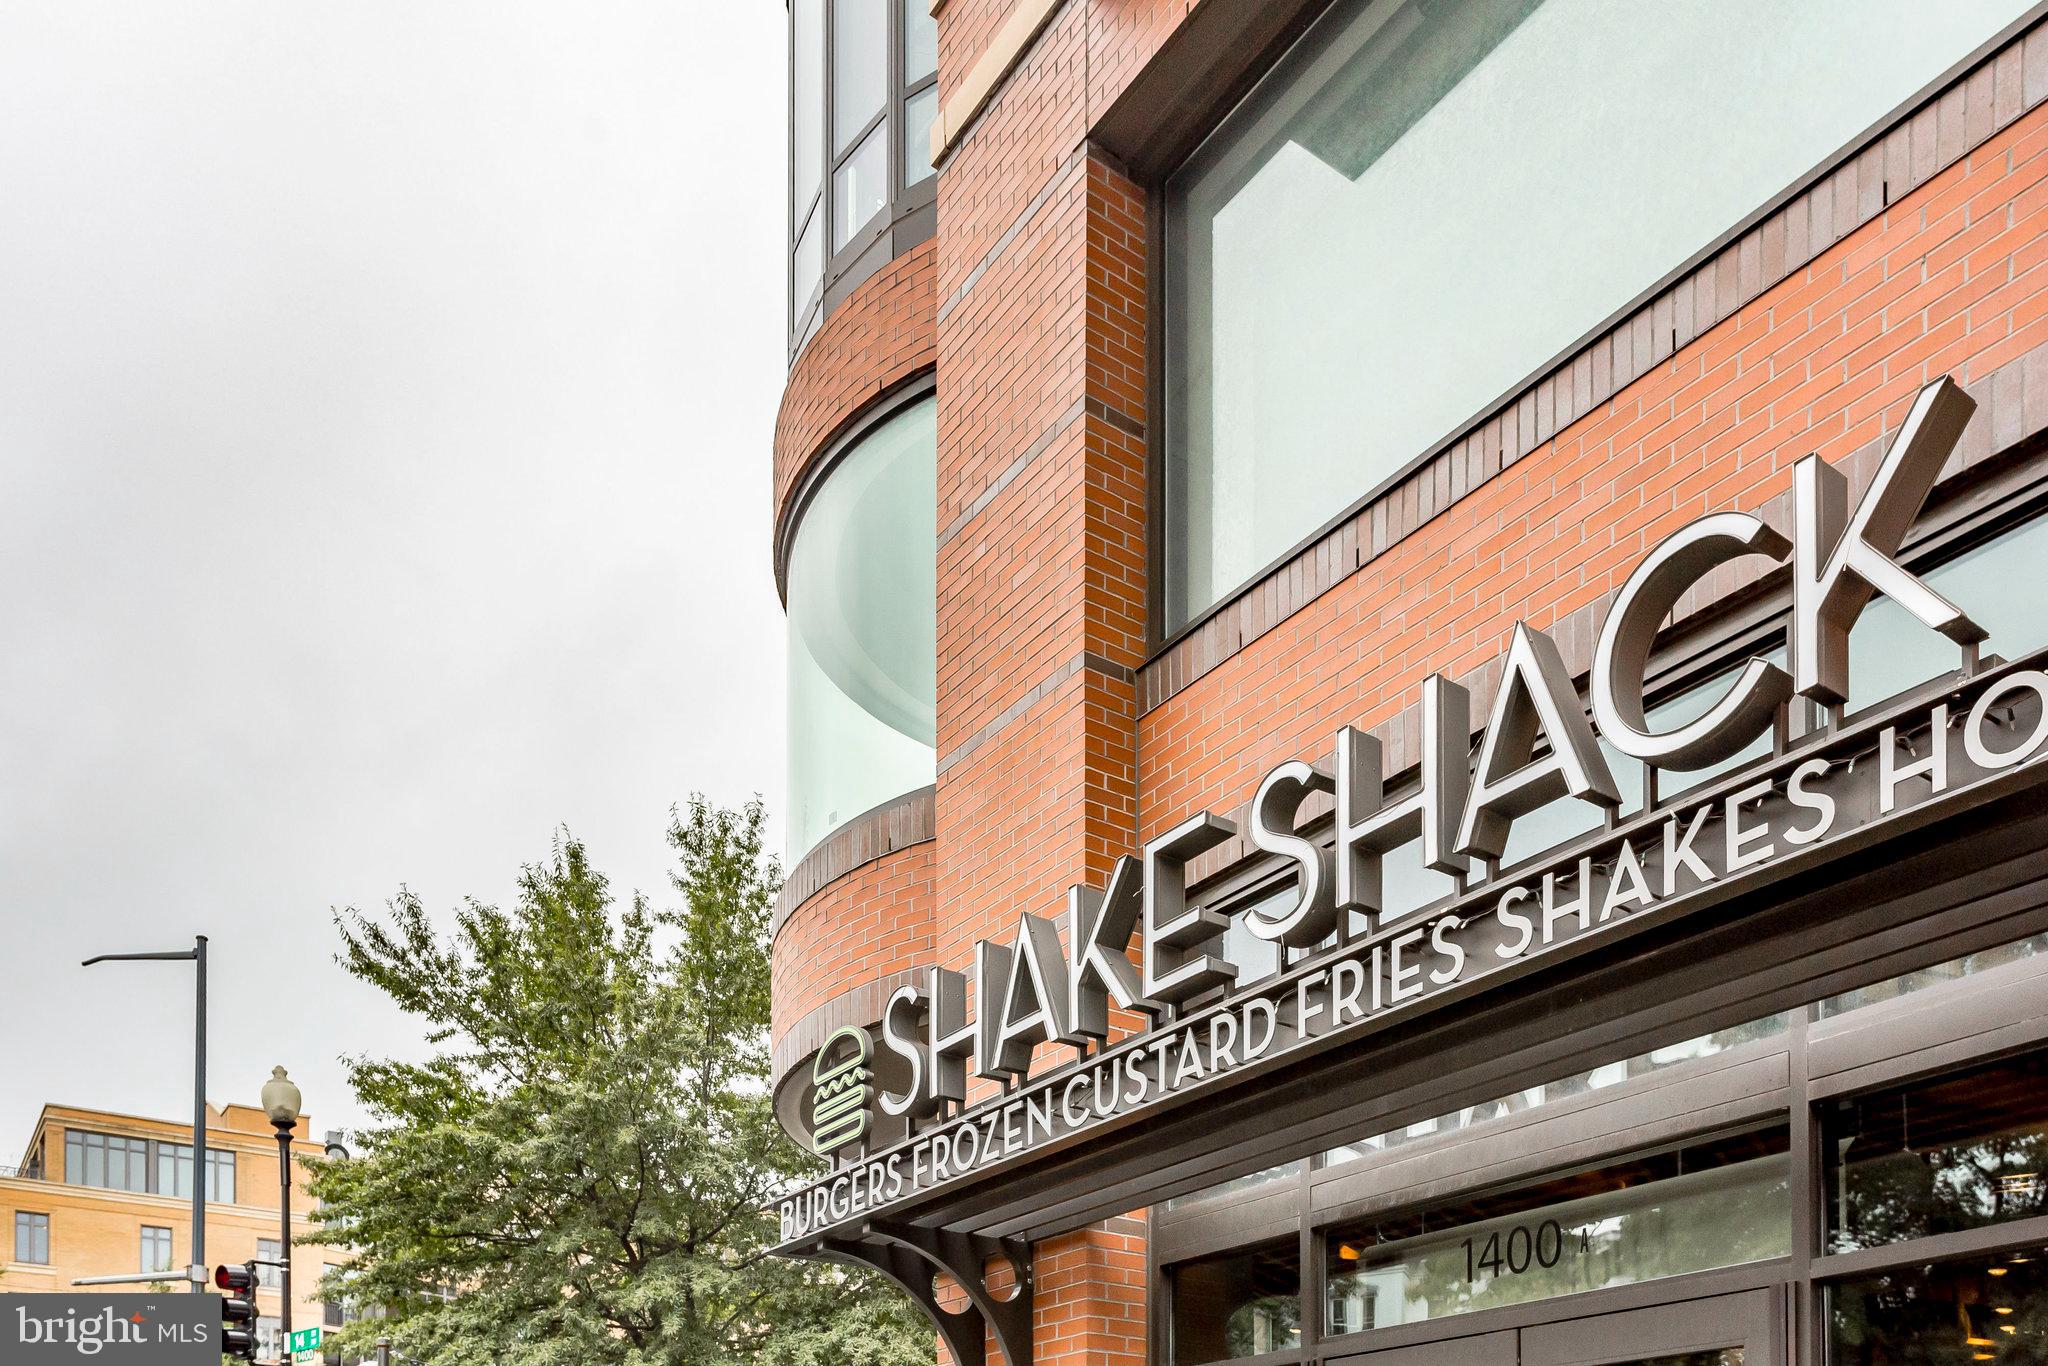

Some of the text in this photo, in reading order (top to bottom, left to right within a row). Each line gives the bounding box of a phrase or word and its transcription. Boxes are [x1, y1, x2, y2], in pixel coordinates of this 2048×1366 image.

[878, 375, 1985, 1118] SHAKE SHACK
[779, 1152, 903, 1243] BURGERS
[912, 1085, 1053, 1190] FROZEN
[1062, 998, 1278, 1127] CUSTARD
[1297, 914, 1466, 1040] FRIES
[1494, 758, 1836, 960] SHAKES
[1460, 1219, 1589, 1283] 1400 A
